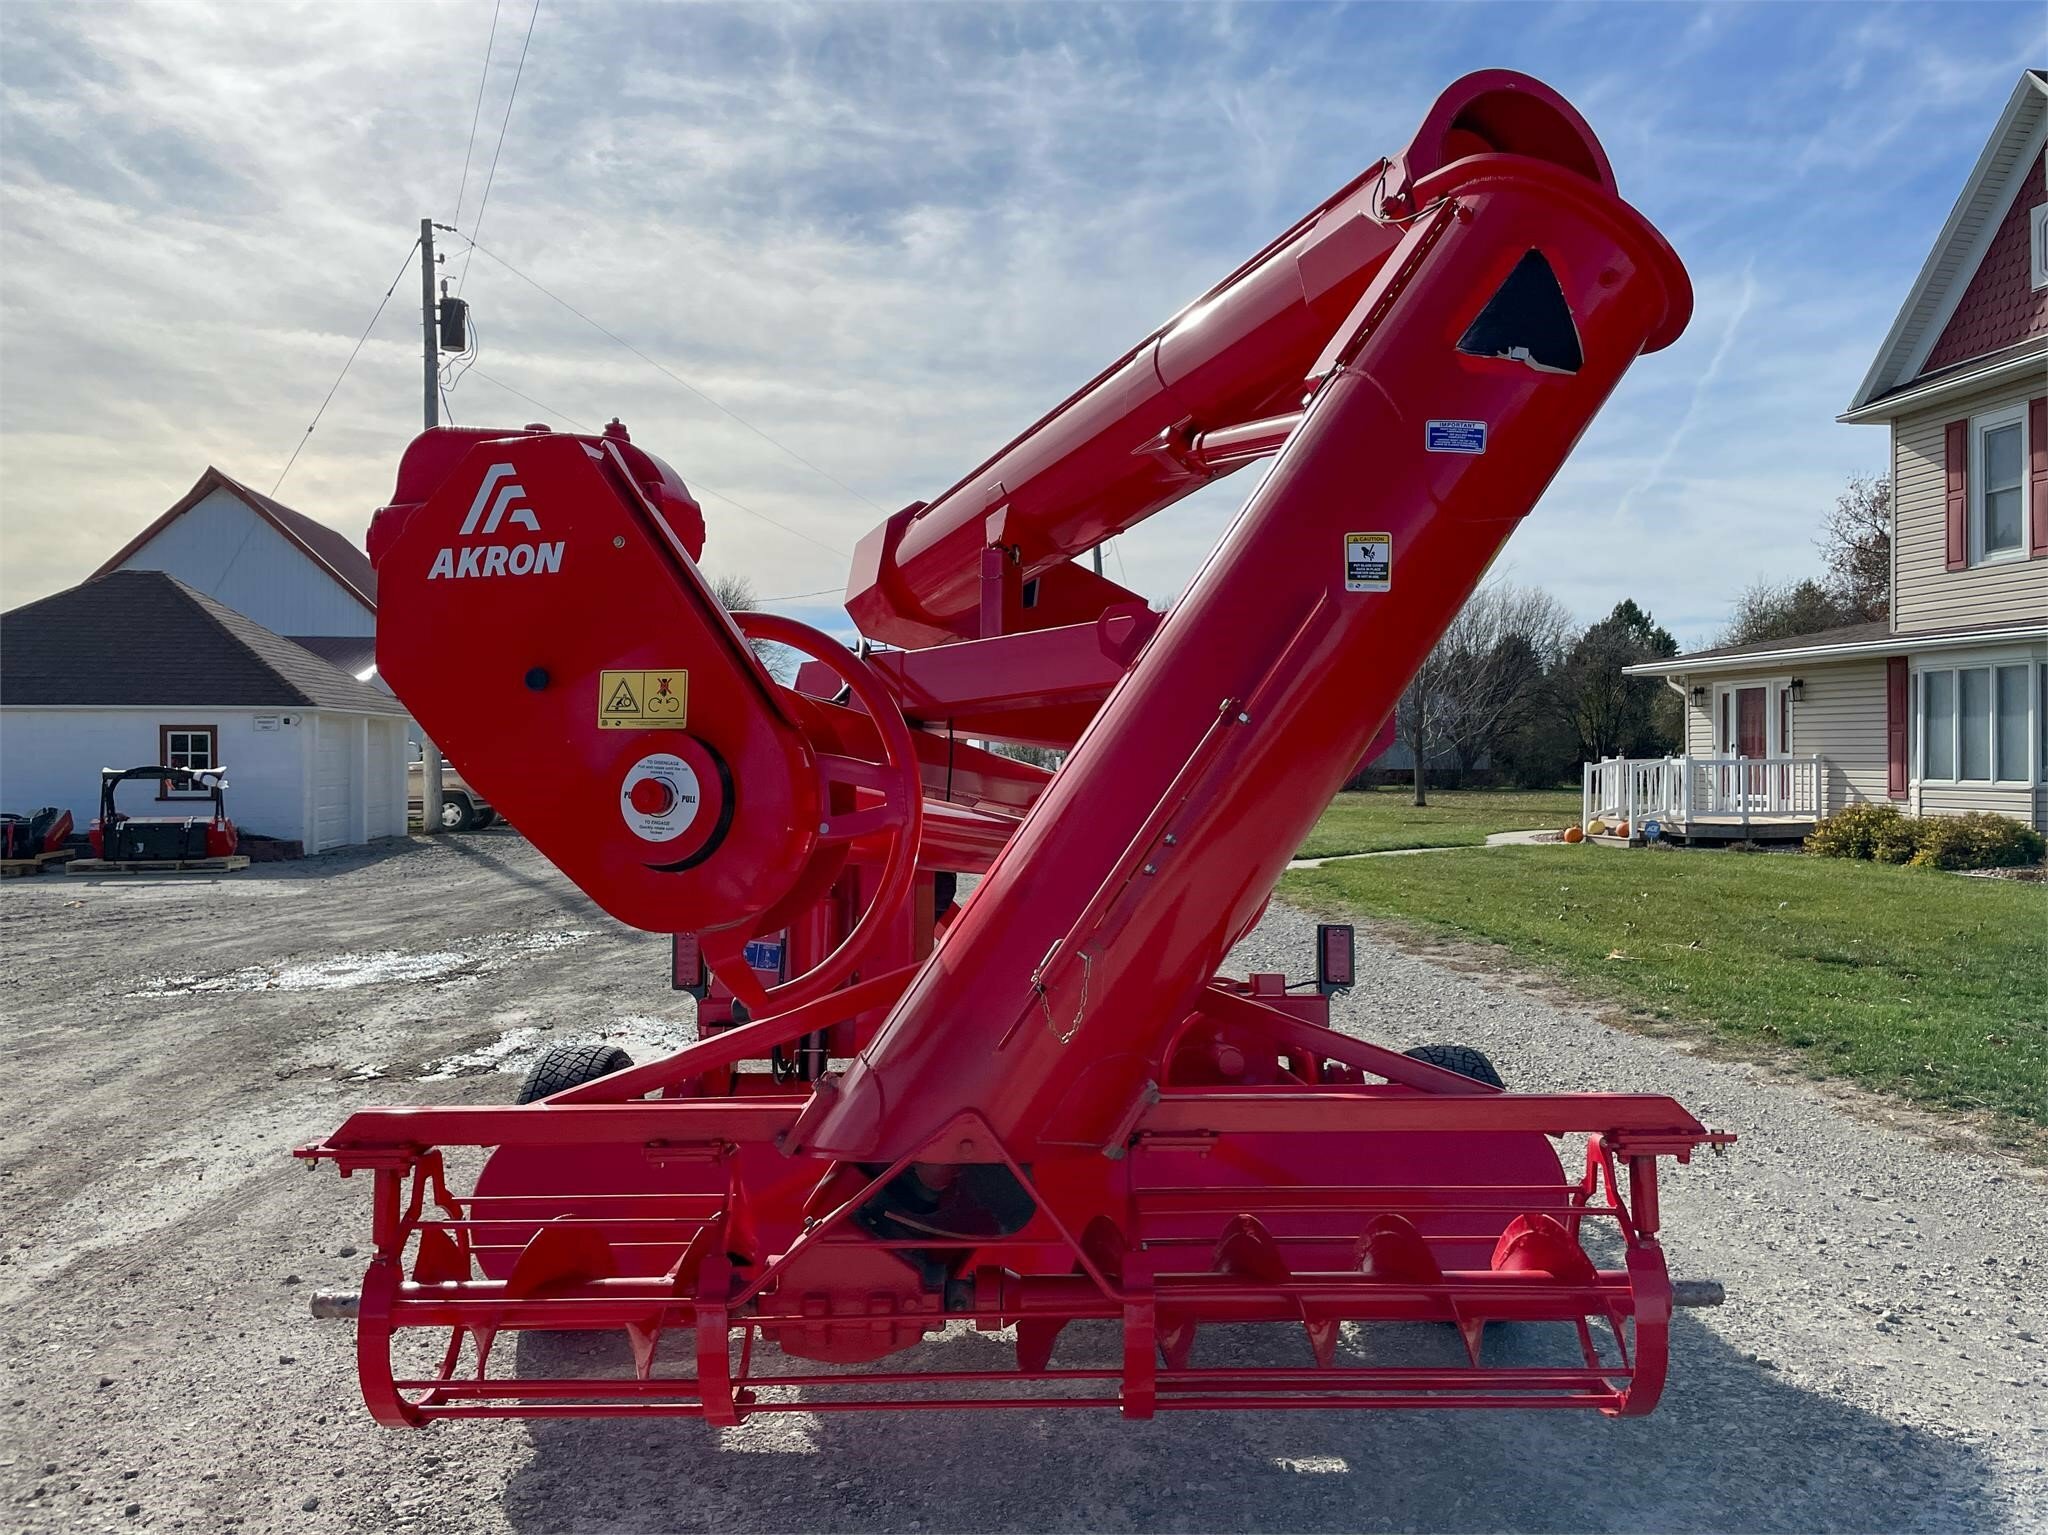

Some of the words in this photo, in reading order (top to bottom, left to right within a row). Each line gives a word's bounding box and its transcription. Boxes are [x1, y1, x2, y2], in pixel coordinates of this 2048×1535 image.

[427, 541, 566, 580] AKRON
[624, 791, 632, 799] PU
[681, 795, 696, 804] PULL
